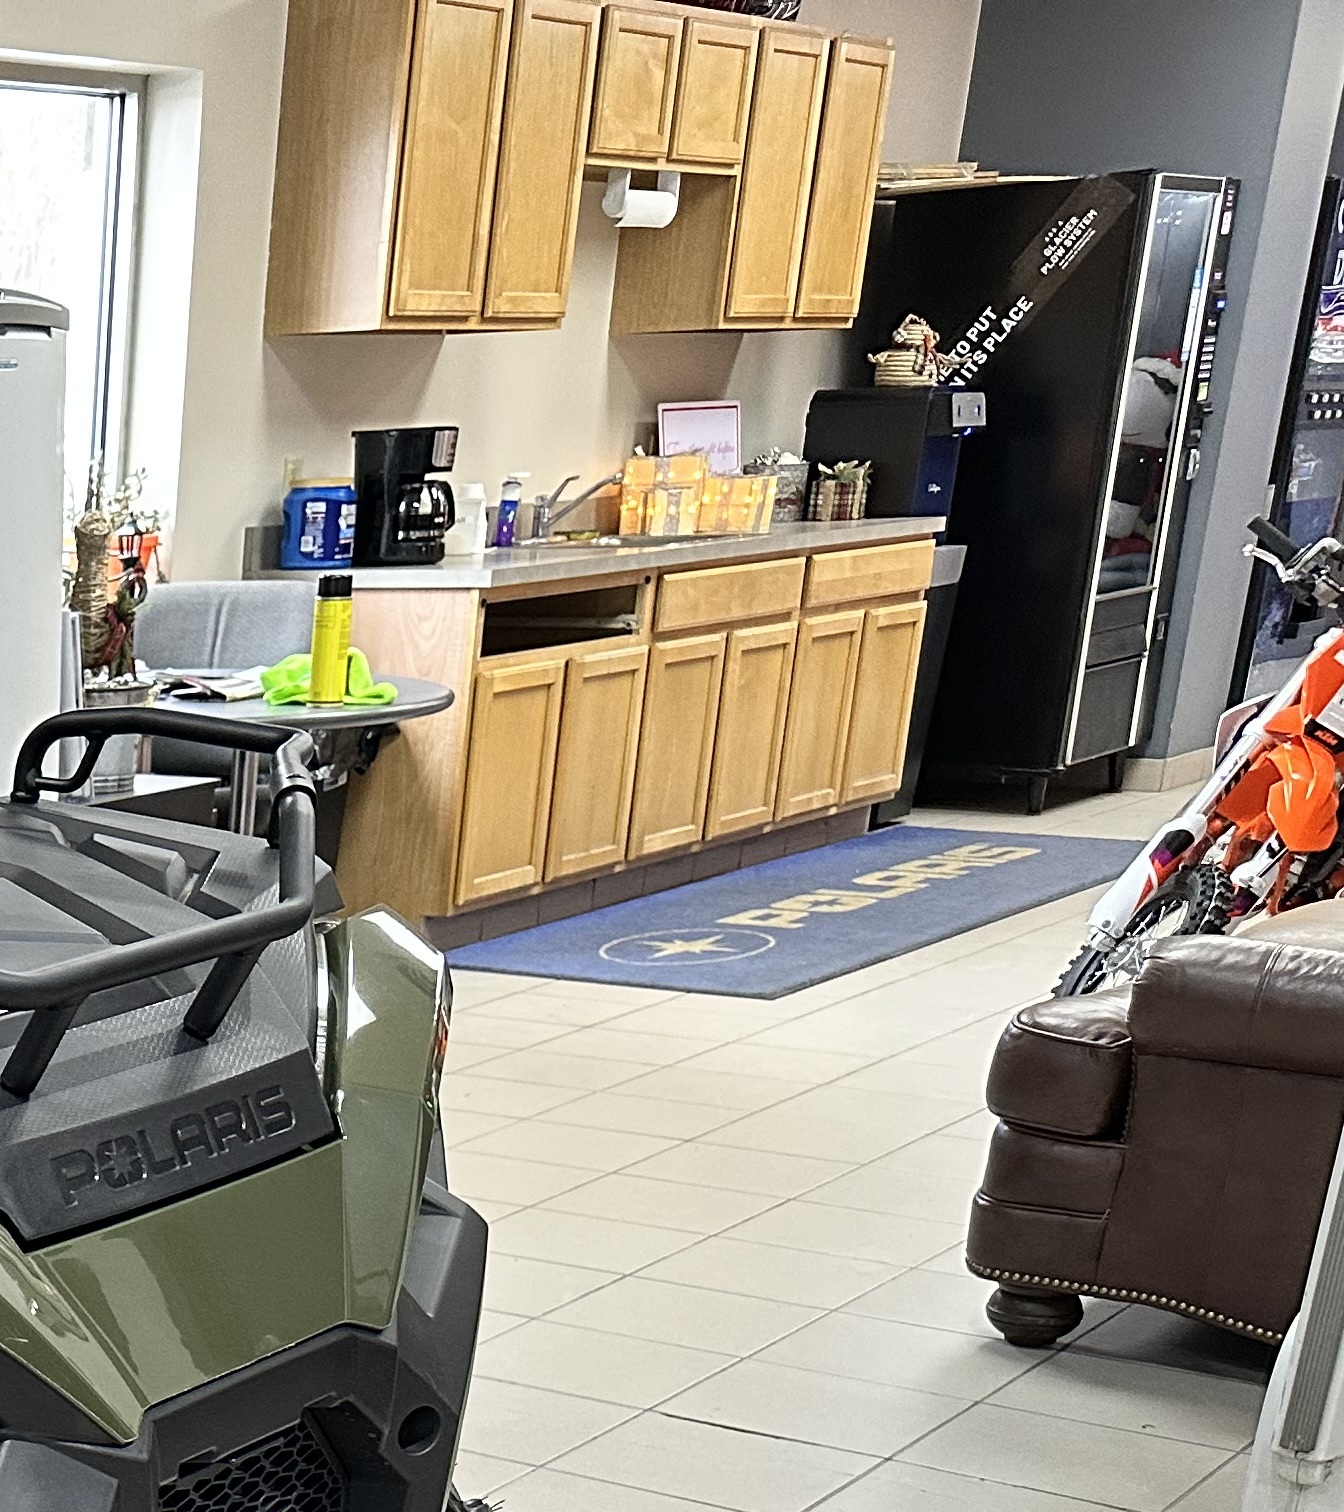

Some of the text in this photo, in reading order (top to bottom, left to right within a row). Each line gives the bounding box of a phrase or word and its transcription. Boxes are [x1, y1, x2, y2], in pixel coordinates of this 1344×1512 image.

[1041, 246, 1065, 274] PLOW
[1064, 209, 1097, 247] SYSTEM
[1044, 217, 1079, 256] GLACIER
[947, 341, 970, 362] TO
[966, 306, 996, 342] PUT
[961, 350, 987, 379] ITS
[983, 296, 1033, 352] PLACE
[716, 842, 1042, 930] POLARIS
[49, 1084, 298, 1209] POLARIS
